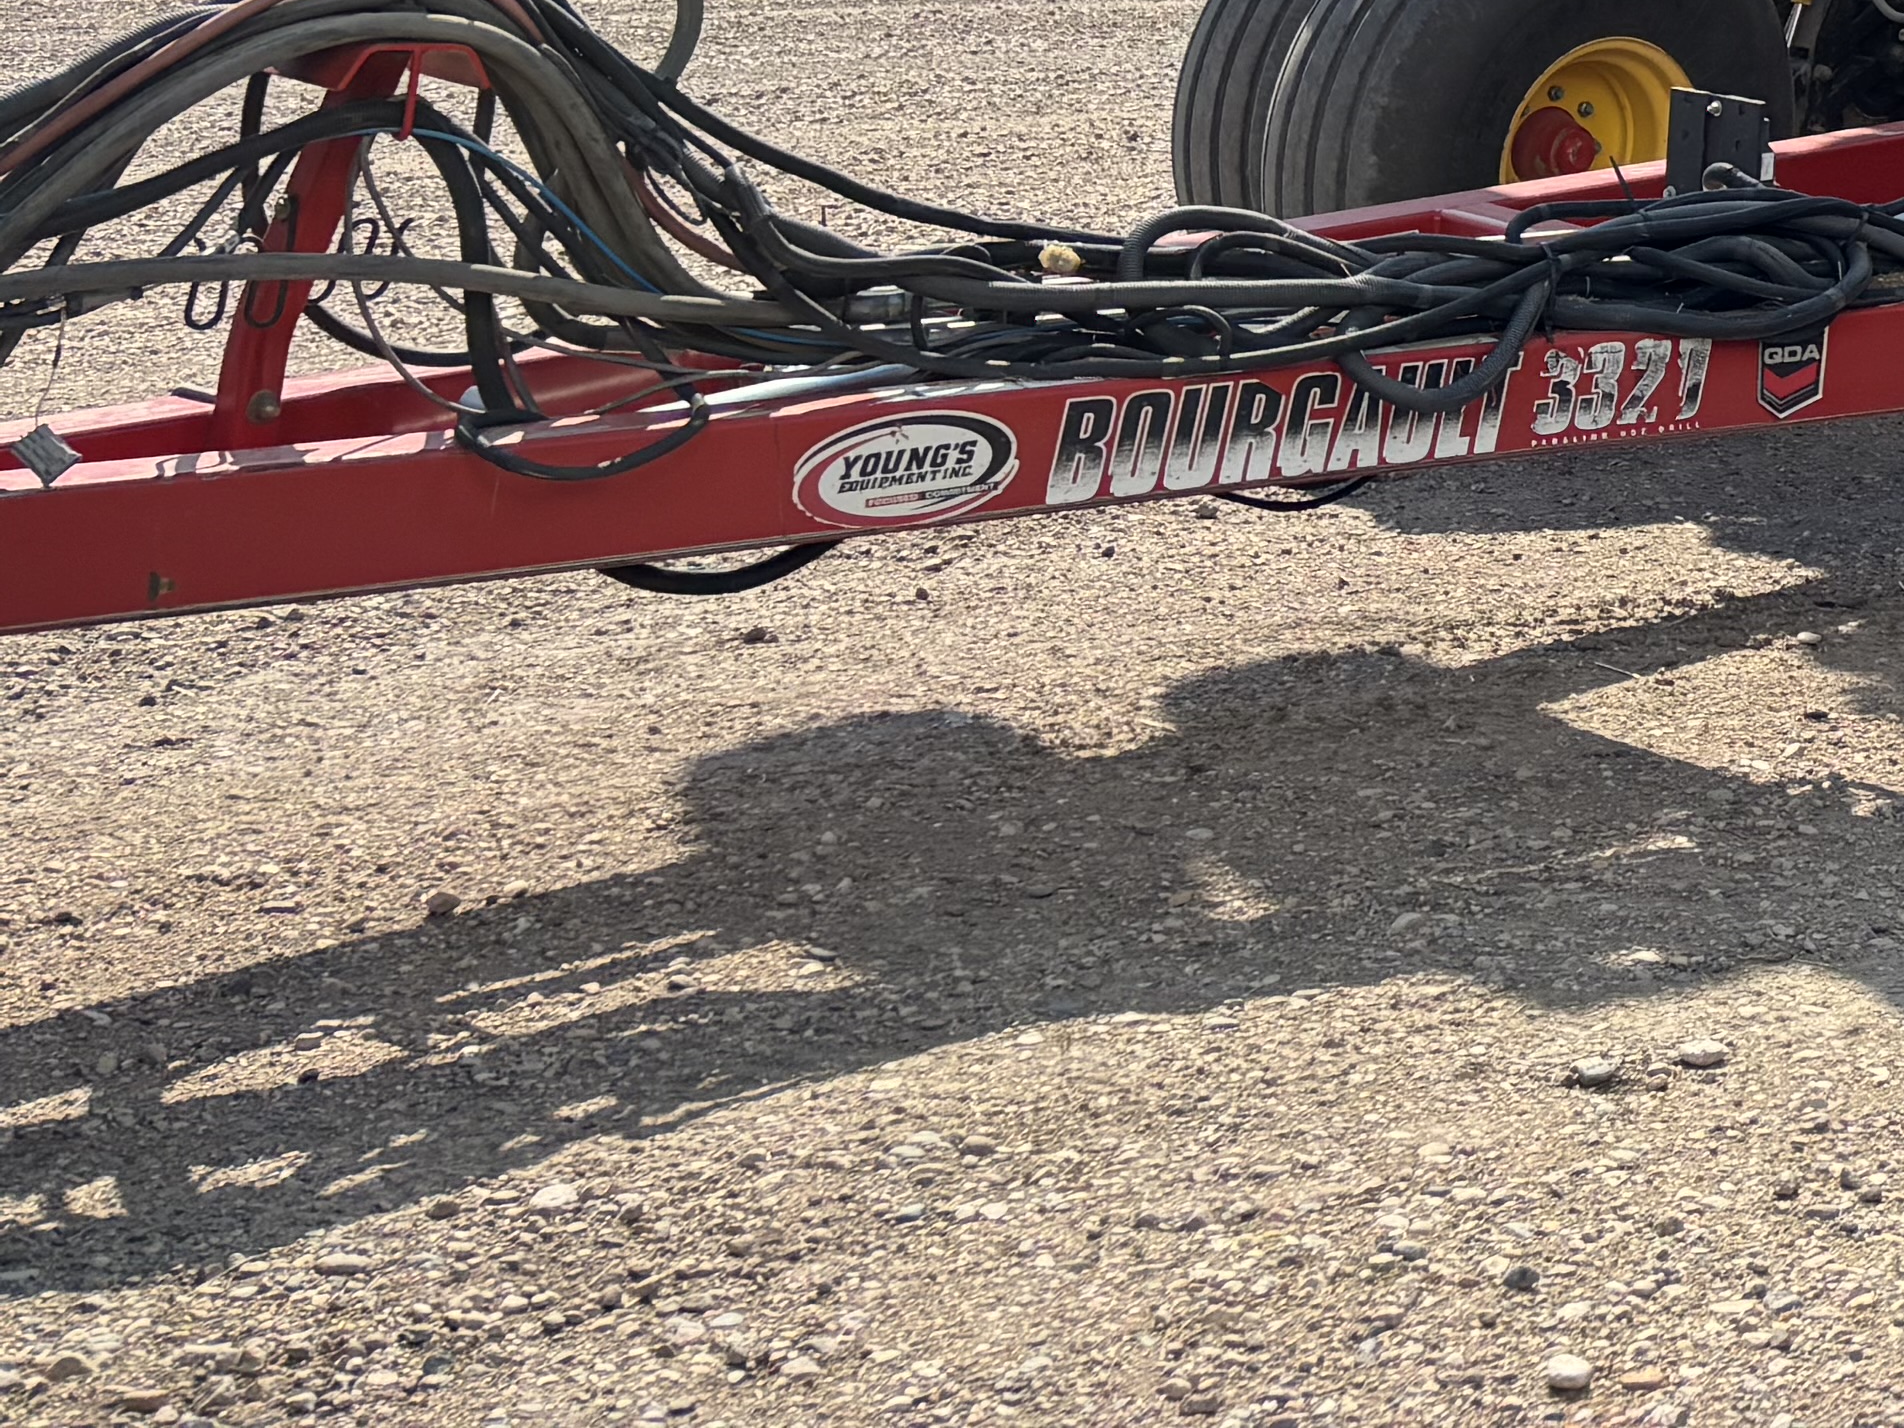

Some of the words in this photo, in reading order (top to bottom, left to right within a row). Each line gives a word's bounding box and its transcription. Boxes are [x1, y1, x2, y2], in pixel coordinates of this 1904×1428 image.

[1763, 344, 1821, 364] QDA
[1045, 351, 1524, 505] BOURGAULT
[839, 440, 978, 480] YOUNG'S
[838, 468, 943, 494] EQUIPMENT
